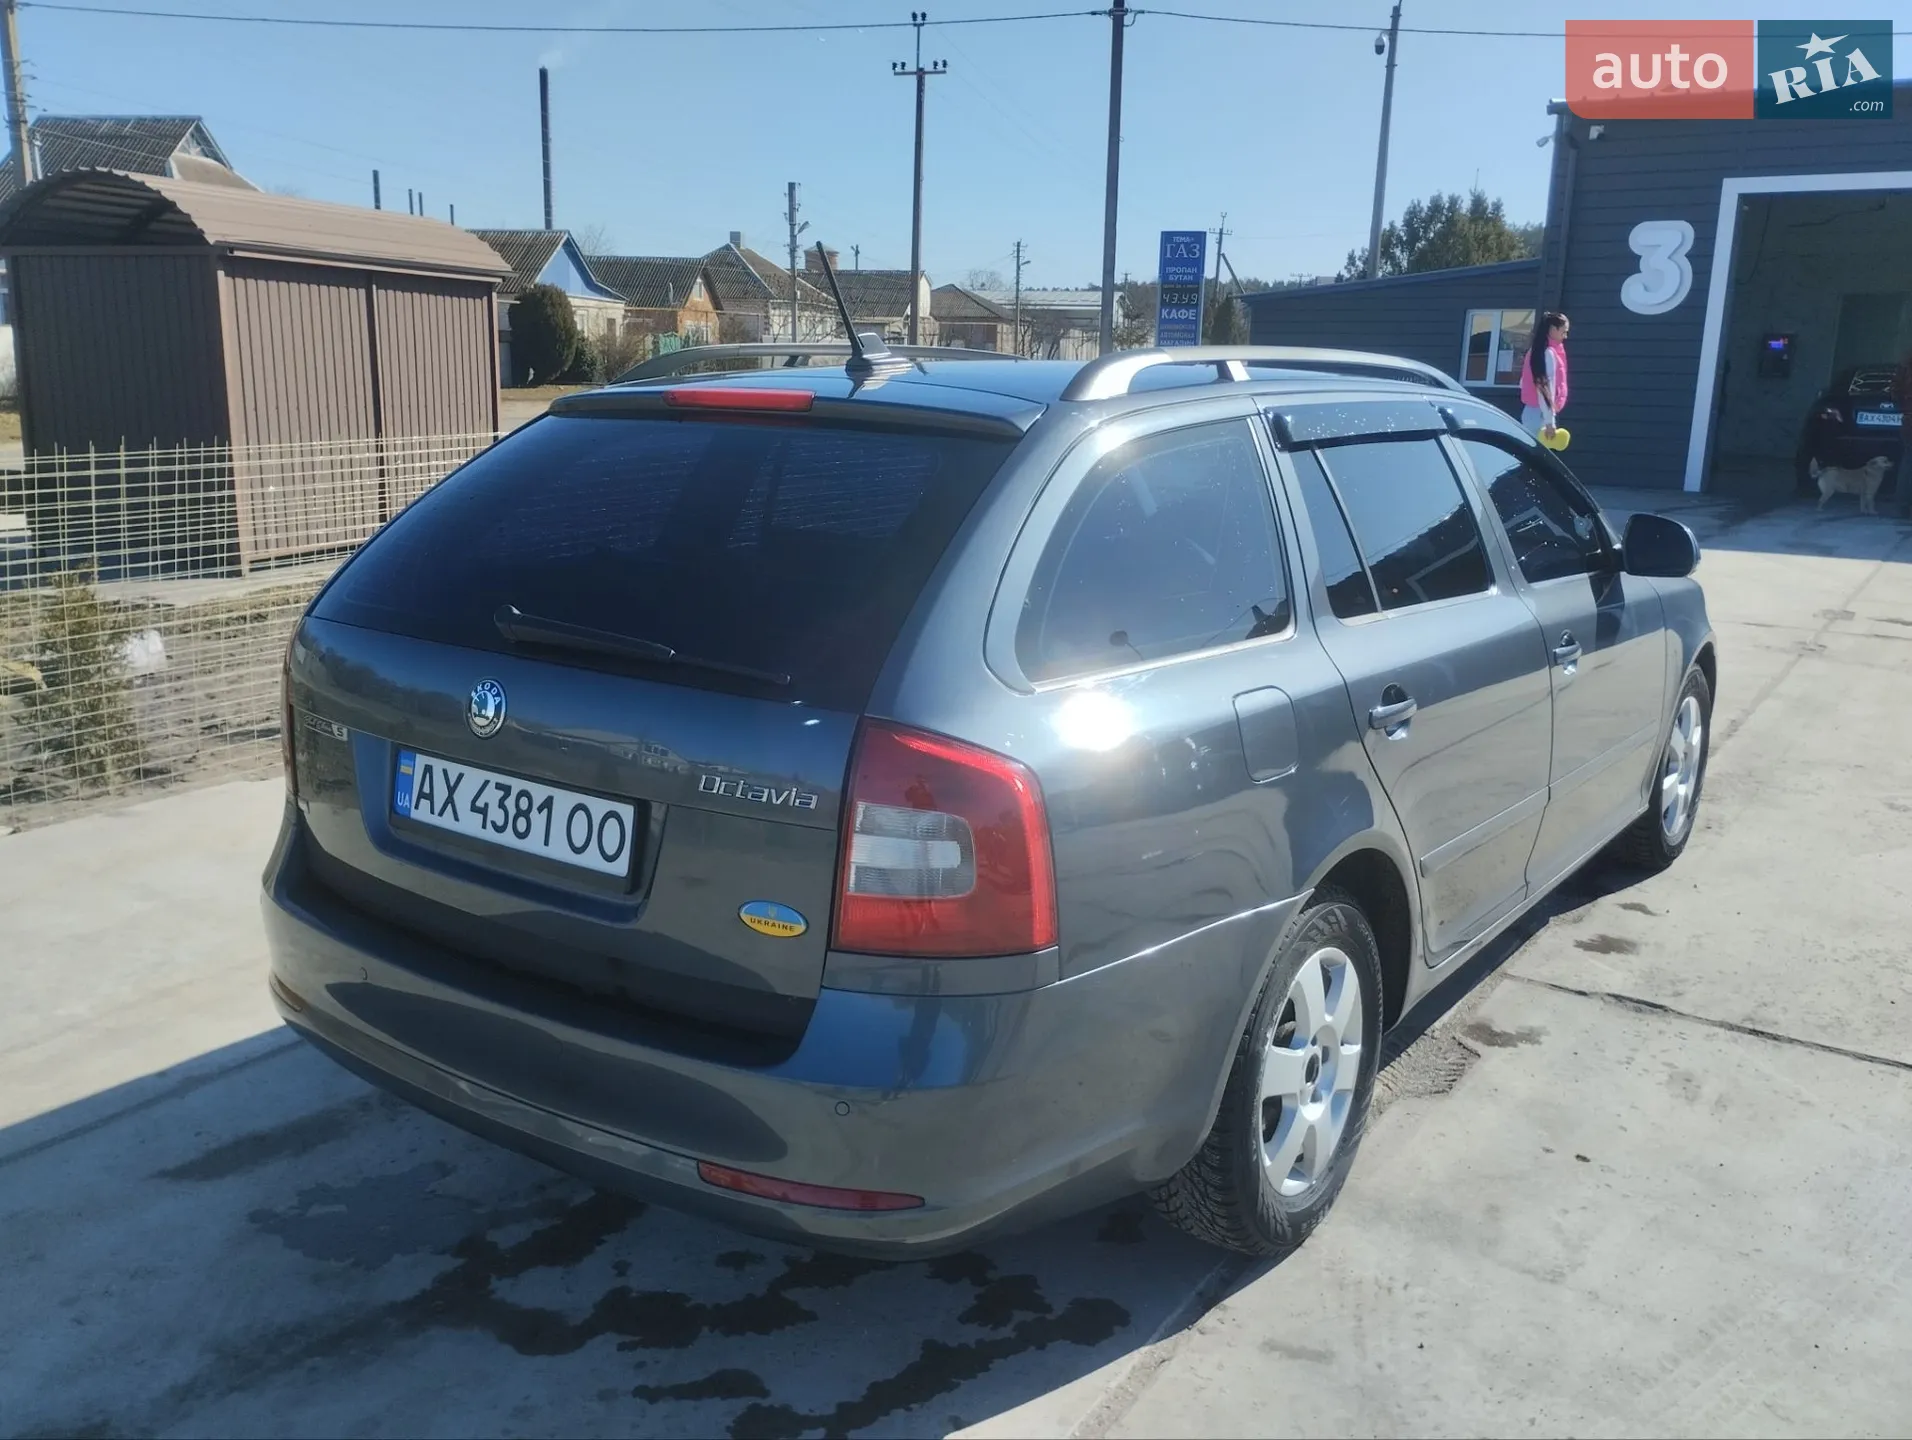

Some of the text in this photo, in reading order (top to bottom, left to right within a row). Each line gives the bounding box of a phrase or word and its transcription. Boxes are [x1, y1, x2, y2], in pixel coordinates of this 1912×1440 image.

[1165, 243, 1201, 258] ГАЗ
[1166, 266, 1198, 274] ПРОПАН
[1621, 220, 1695, 315] 3
[1161, 308, 1197, 320] КАФЕ
[397, 791, 411, 809] UA
[698, 773, 820, 811] Octavia
[413, 763, 465, 822] AX
[470, 779, 555, 847] 4381
[749, 917, 797, 932] UKRAINE
